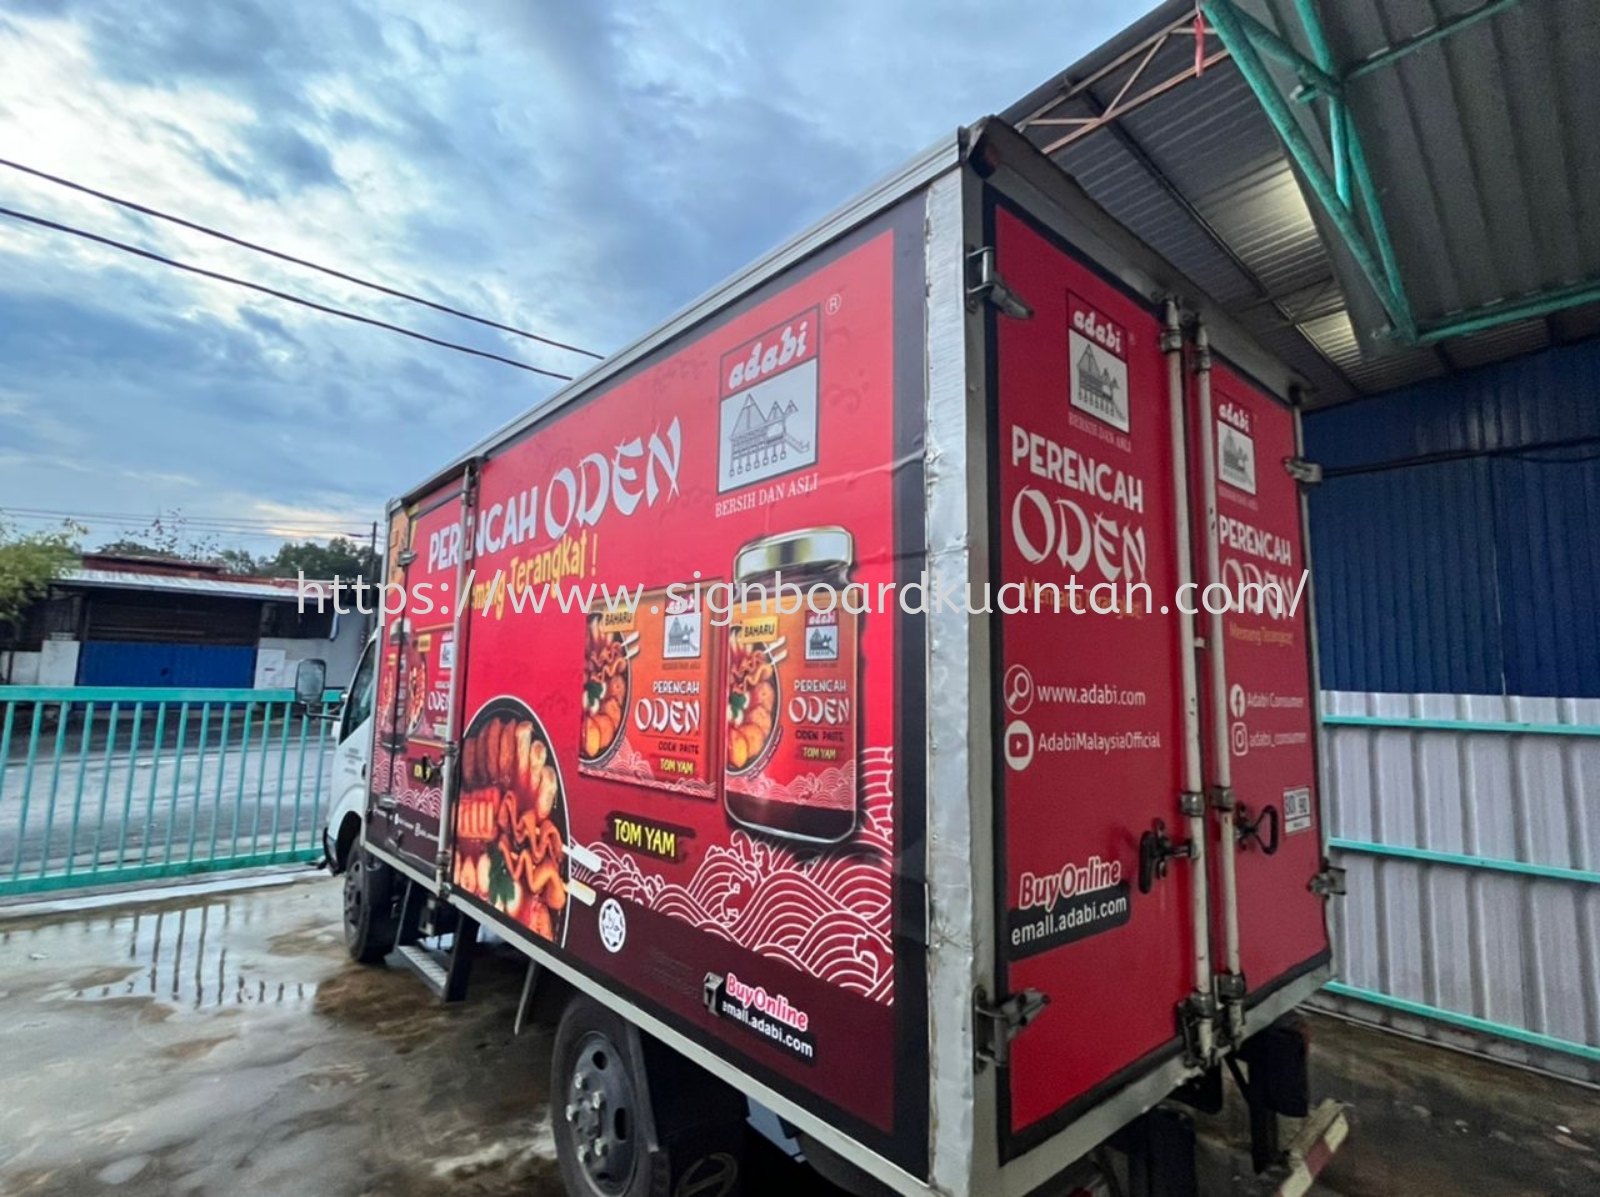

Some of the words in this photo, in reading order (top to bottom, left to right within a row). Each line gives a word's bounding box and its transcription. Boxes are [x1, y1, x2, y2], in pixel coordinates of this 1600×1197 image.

[1073, 310, 1121, 353] adabi
[728, 320, 808, 390] adabi
[1218, 402, 1250, 434] adabi
[1011, 424, 1144, 514] PERENCAH
[427, 486, 539, 575] PERNCAH
[544, 415, 683, 541] ODEN
[714, 493, 756, 519] BERSIH
[758, 484, 786, 507] DAN
[787, 472, 820, 494] ASLI
[1011, 484, 1148, 586] ODEN
[1219, 514, 1292, 567] PERENCAH
[744, 621, 775, 638] BAHARU
[652, 680, 700, 694] PERENCAH
[794, 679, 847, 693] PERENCAH
[1036, 683, 1146, 707] www.adabi.com
[634, 697, 700, 734] ODEN
[788, 695, 850, 725] ODEN
[803, 746, 820, 758] TOM
[820, 748, 837, 760] YAM
[1038, 731, 1162, 755] AdabiMalaysiaOfficial
[660, 758, 676, 772] TOM
[677, 760, 694, 775] YAM
[613, 817, 642, 845] TOM
[644, 826, 676, 857] YAM
[1018, 855, 1122, 911] BuyOnline
[1010, 894, 1128, 946] emall.adabi.com
[725, 971, 809, 1032] BuyOnline
[721, 1000, 814, 1058] emall.adabi.com
